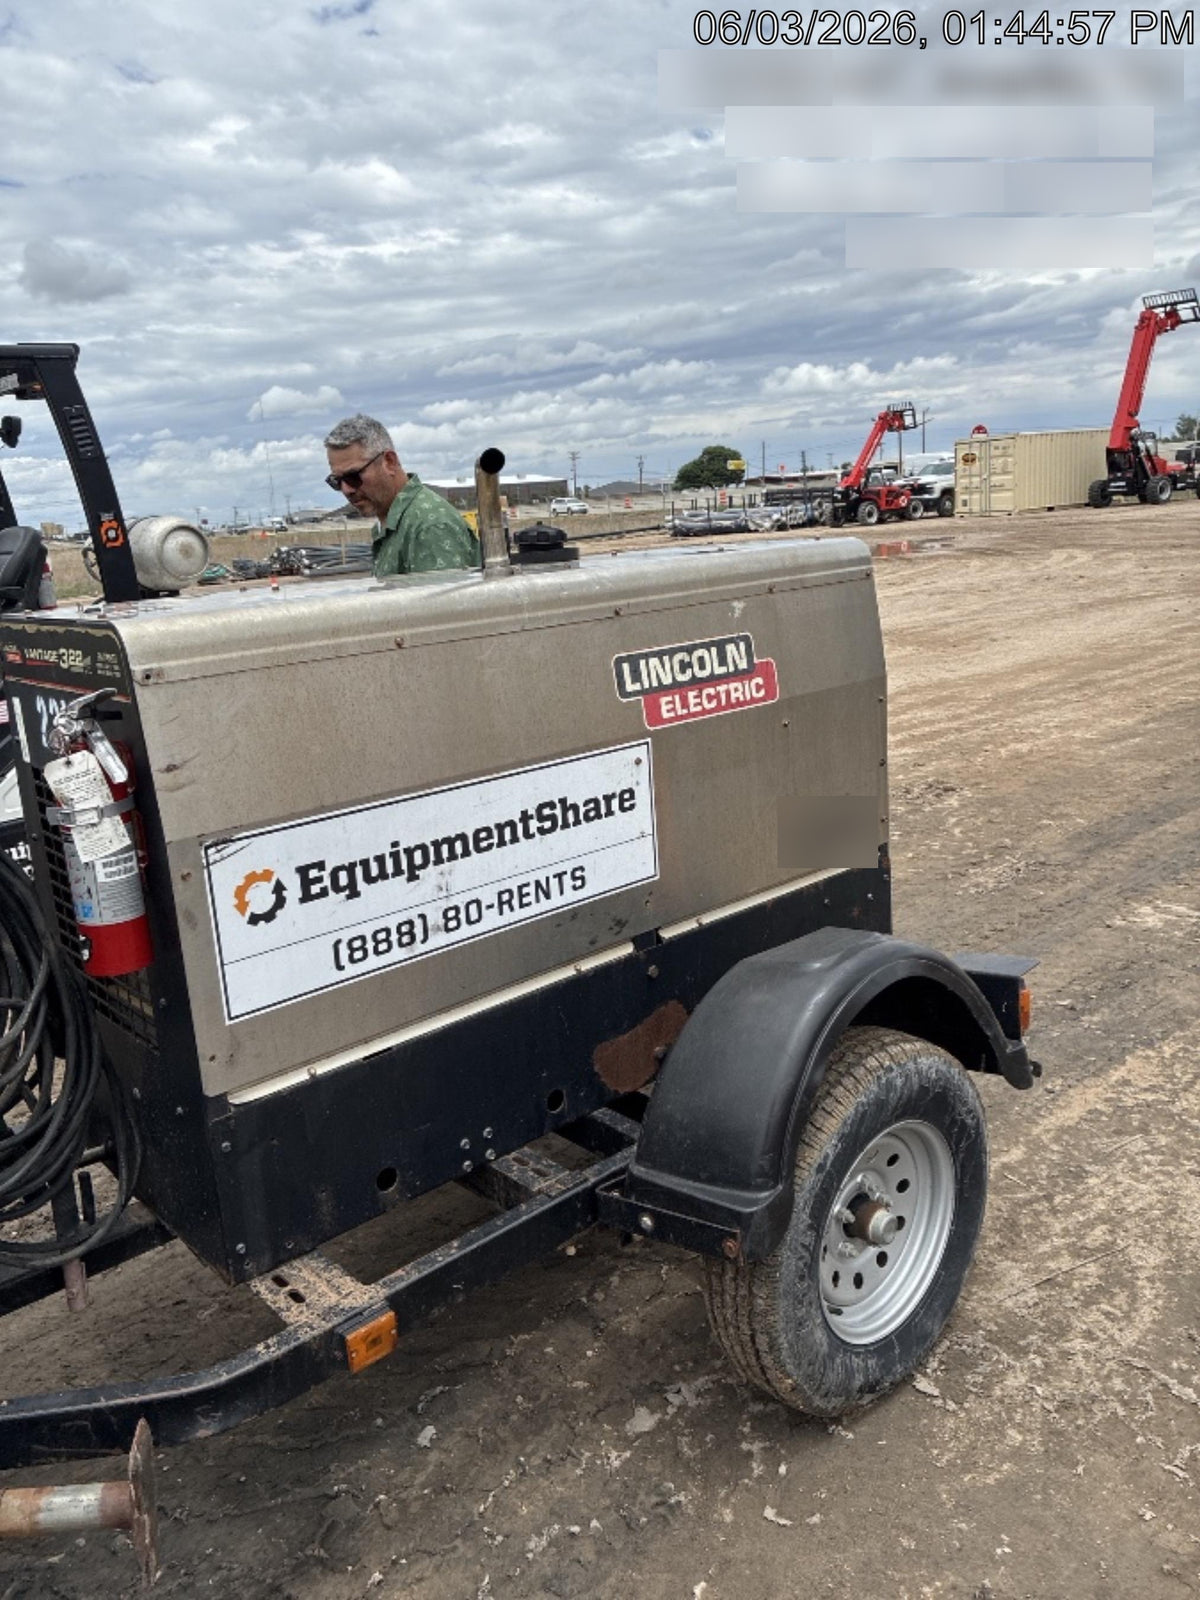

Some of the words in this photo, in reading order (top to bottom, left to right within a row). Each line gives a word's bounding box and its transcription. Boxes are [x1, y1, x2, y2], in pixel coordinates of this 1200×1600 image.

[621, 641, 749, 692] LINCOLN
[660, 677, 766, 719] ELECTRIC
[296, 786, 637, 905] EquipmentShare
[332, 914, 430, 972] (888)
[442, 866, 588, 932] 80-RENTS
